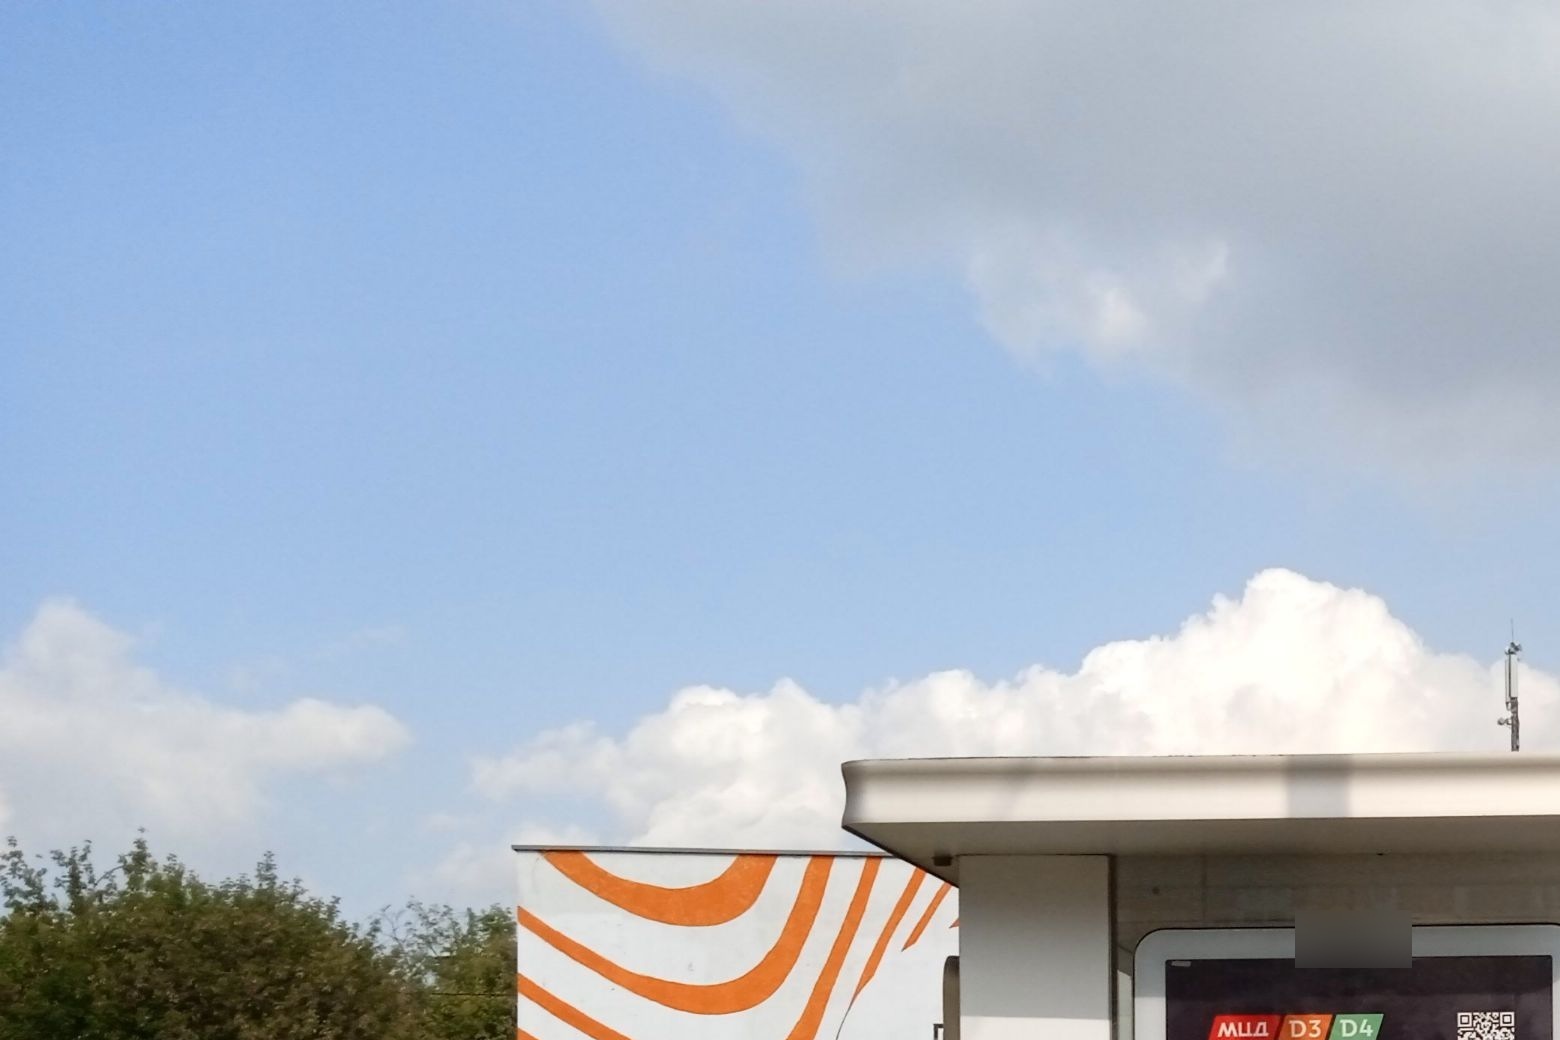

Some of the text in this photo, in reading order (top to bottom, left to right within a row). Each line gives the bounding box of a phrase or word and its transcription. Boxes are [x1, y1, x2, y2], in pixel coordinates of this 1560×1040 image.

[1217, 1019, 1374, 1038] МЦД D3 D4
